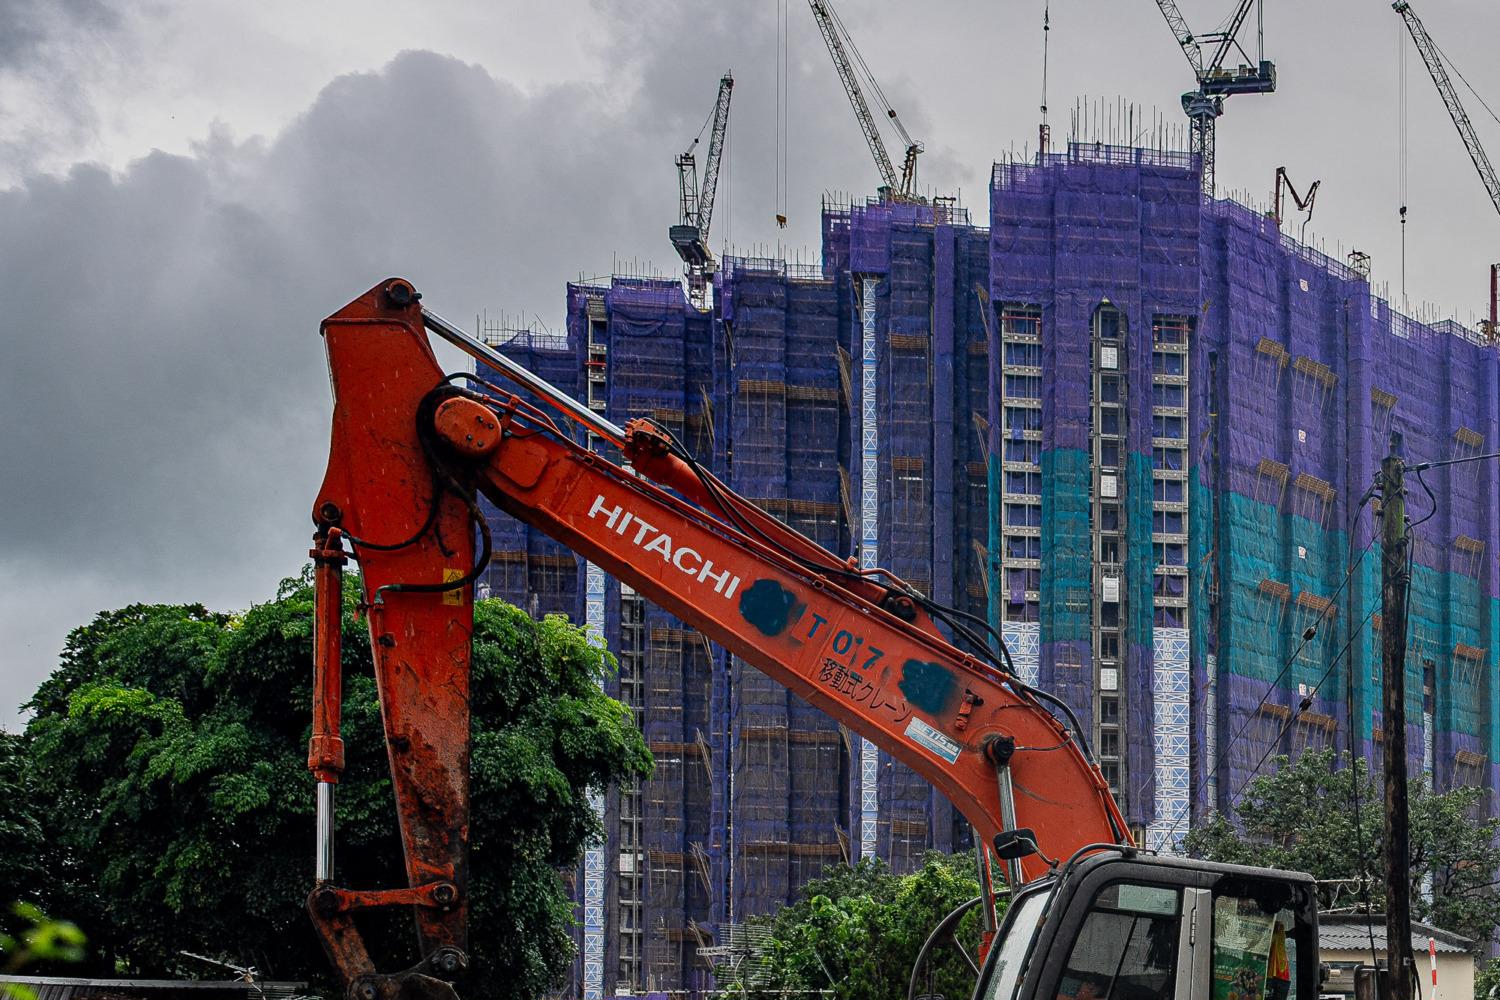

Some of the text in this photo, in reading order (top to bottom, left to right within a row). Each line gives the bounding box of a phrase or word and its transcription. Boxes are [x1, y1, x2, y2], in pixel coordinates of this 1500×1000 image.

[587, 494, 742, 600] HITACHI
[818, 657, 914, 723] 移動式クレーン
